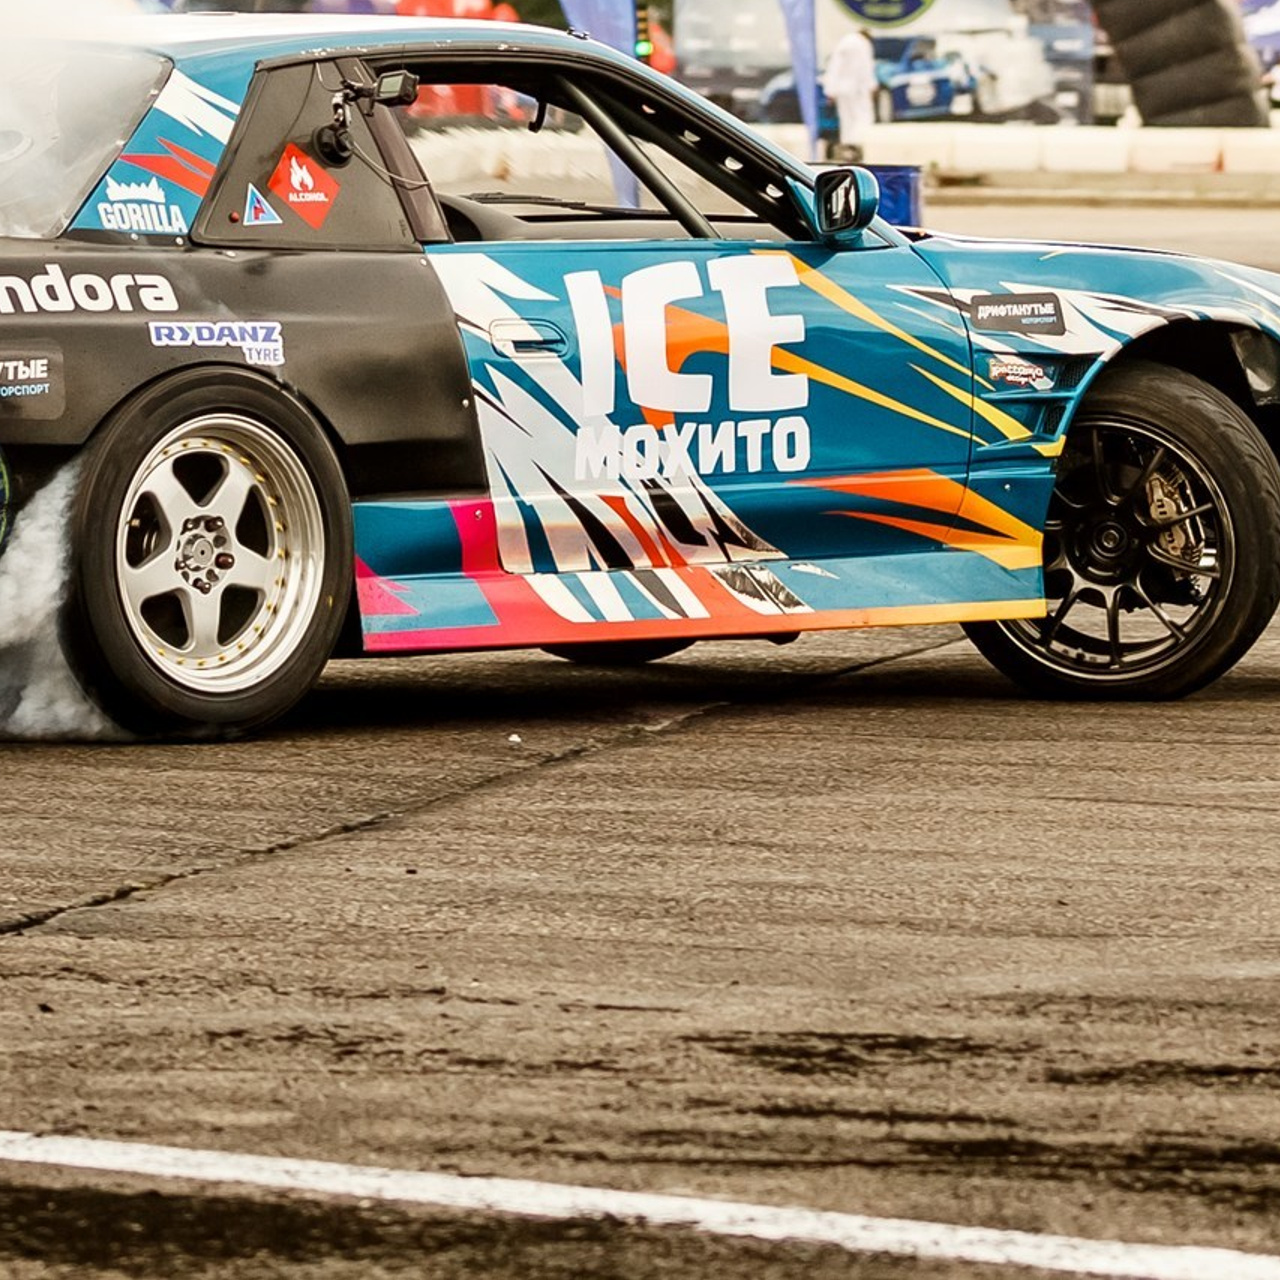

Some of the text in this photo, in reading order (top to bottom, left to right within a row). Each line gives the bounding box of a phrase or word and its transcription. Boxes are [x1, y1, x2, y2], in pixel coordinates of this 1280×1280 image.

[97, 202, 187, 233] GORILLA
[154, 325, 280, 343] RYDANZ
[563, 255, 809, 416] ICE
[247, 347, 281, 362] TYRE
[574, 416, 811, 480] МОХИТО
